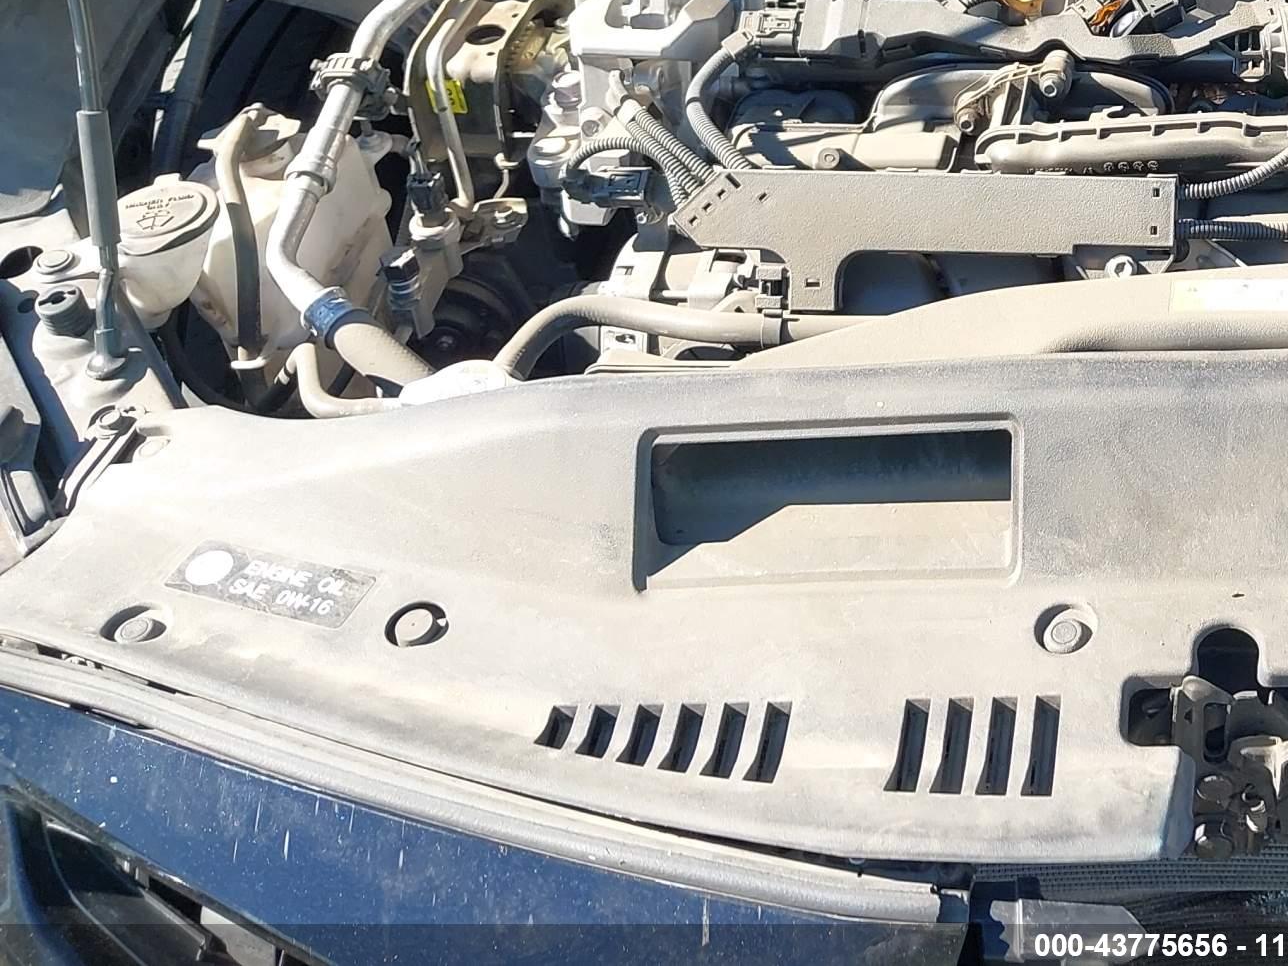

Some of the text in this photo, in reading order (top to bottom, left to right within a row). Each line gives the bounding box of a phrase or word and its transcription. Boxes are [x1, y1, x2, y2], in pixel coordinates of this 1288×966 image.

[228, 578, 272, 600] SAE
[243, 560, 346, 597] ENGINE OIL
